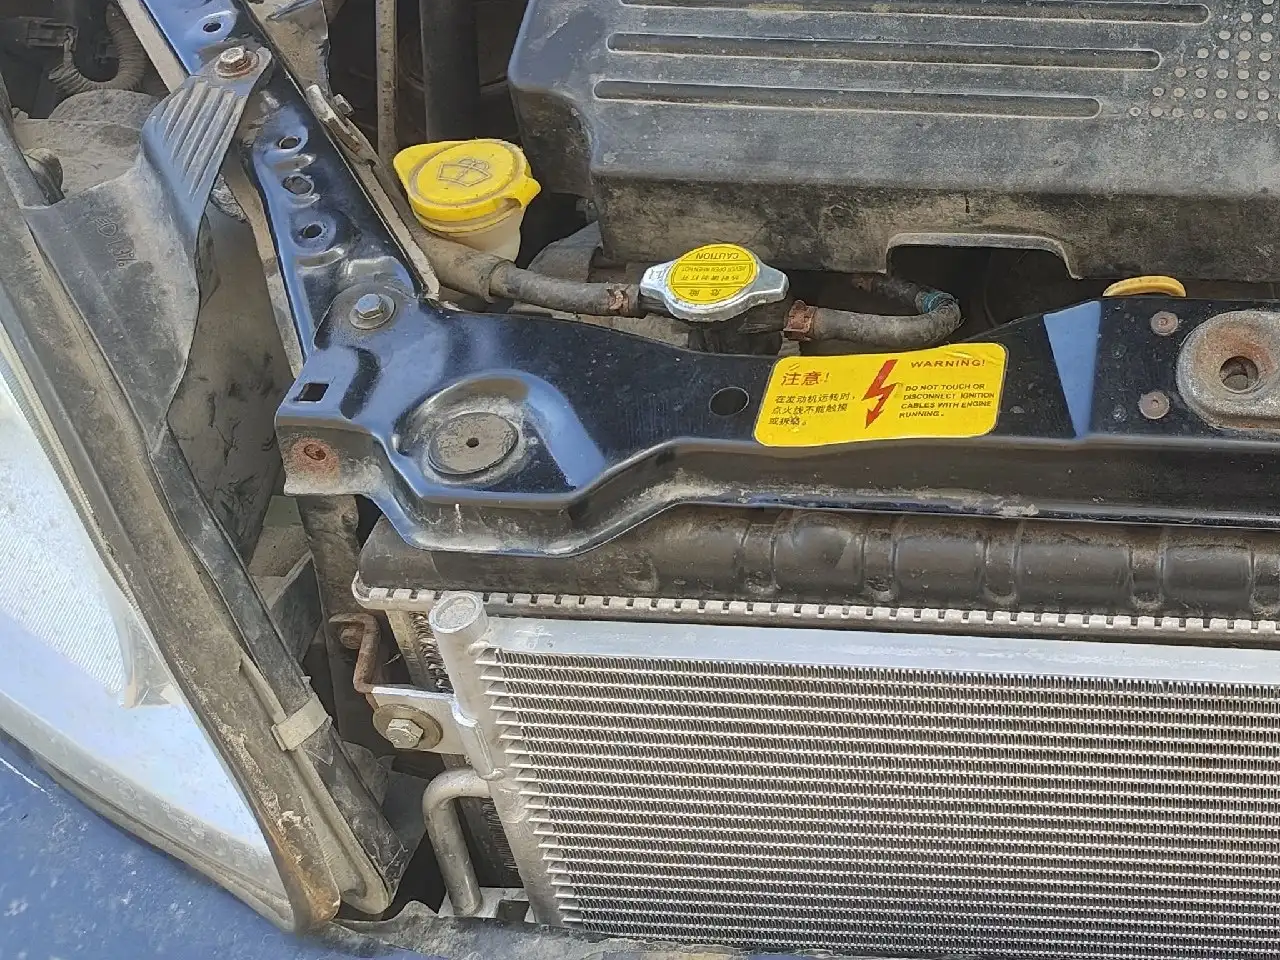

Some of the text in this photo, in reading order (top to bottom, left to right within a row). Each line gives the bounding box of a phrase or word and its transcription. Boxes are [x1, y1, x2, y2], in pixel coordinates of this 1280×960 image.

[695, 252, 740, 260] CAUTION
[910, 359, 986, 369] WARNING!
[941, 383, 971, 391] TOUCH
[903, 392, 995, 401] DISCONNECT IGNITION
